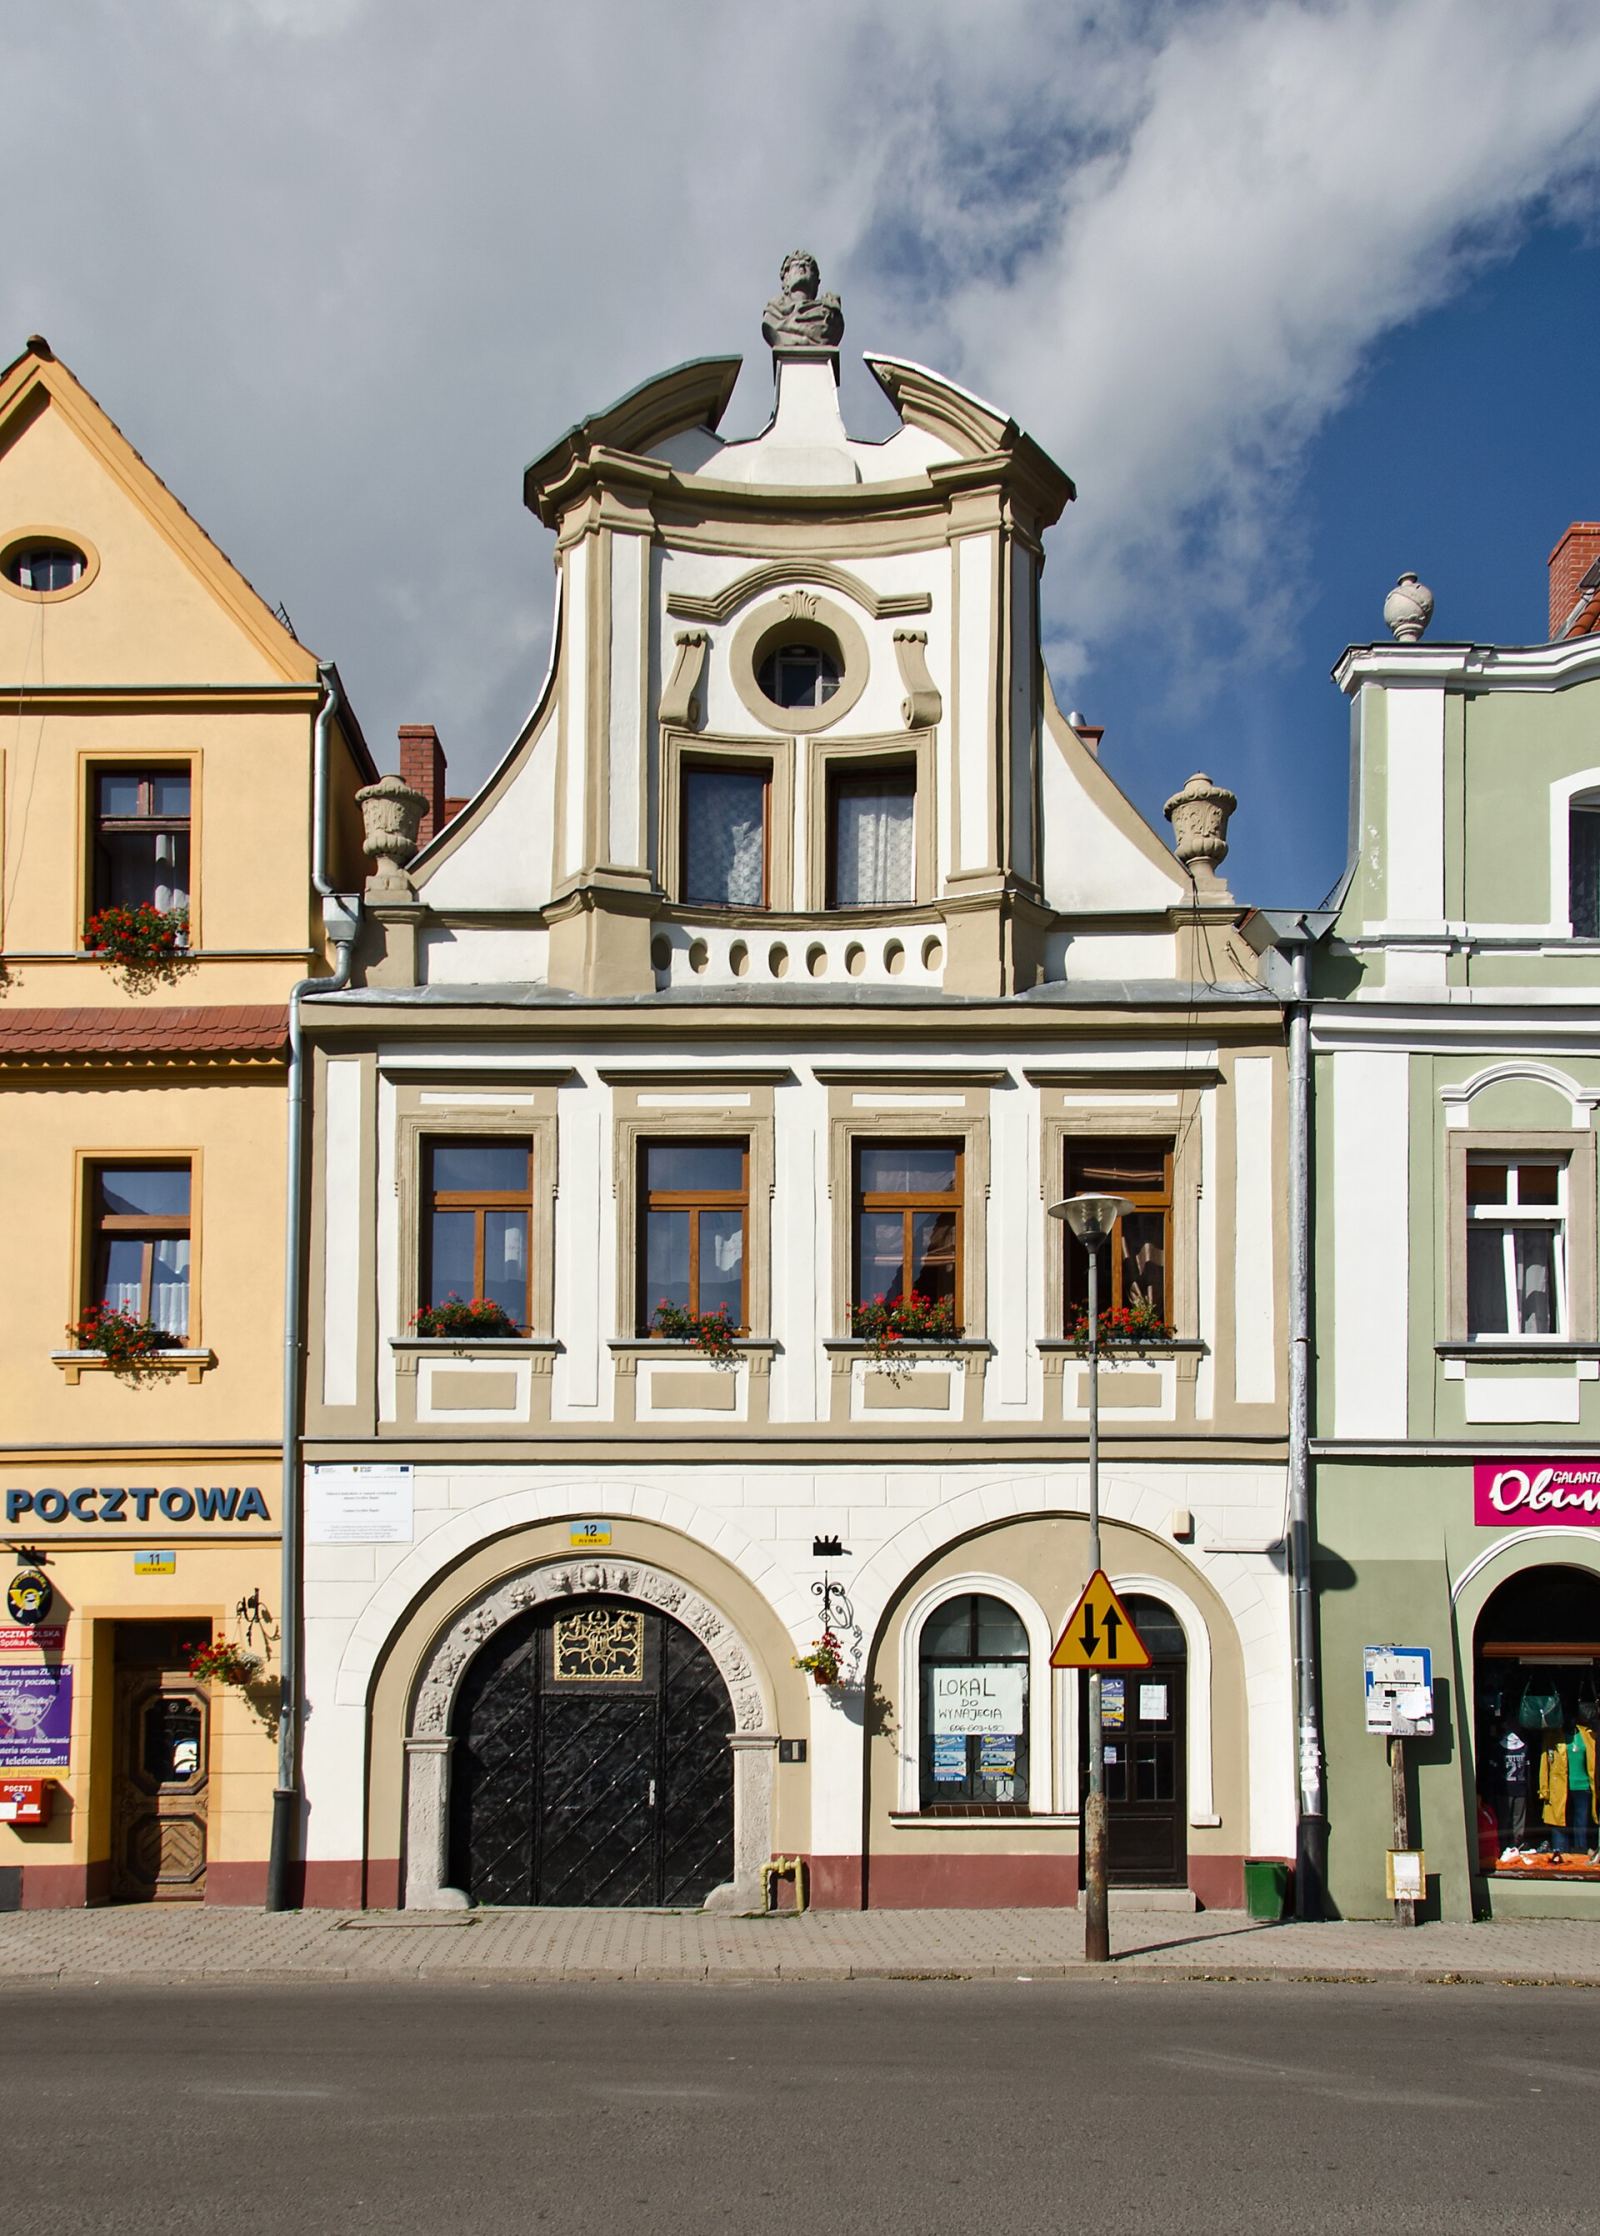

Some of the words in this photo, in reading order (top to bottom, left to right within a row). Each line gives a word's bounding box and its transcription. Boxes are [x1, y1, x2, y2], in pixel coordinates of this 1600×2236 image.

[6, 1487, 271, 1523] POCZTOWA
[583, 1524, 597, 1536] 12
[149, 1553, 160, 1565] 11
[26, 1630, 60, 1638] POLSKA
[939, 1678, 996, 1697] LOKAL
[961, 1699, 979, 1707] DO
